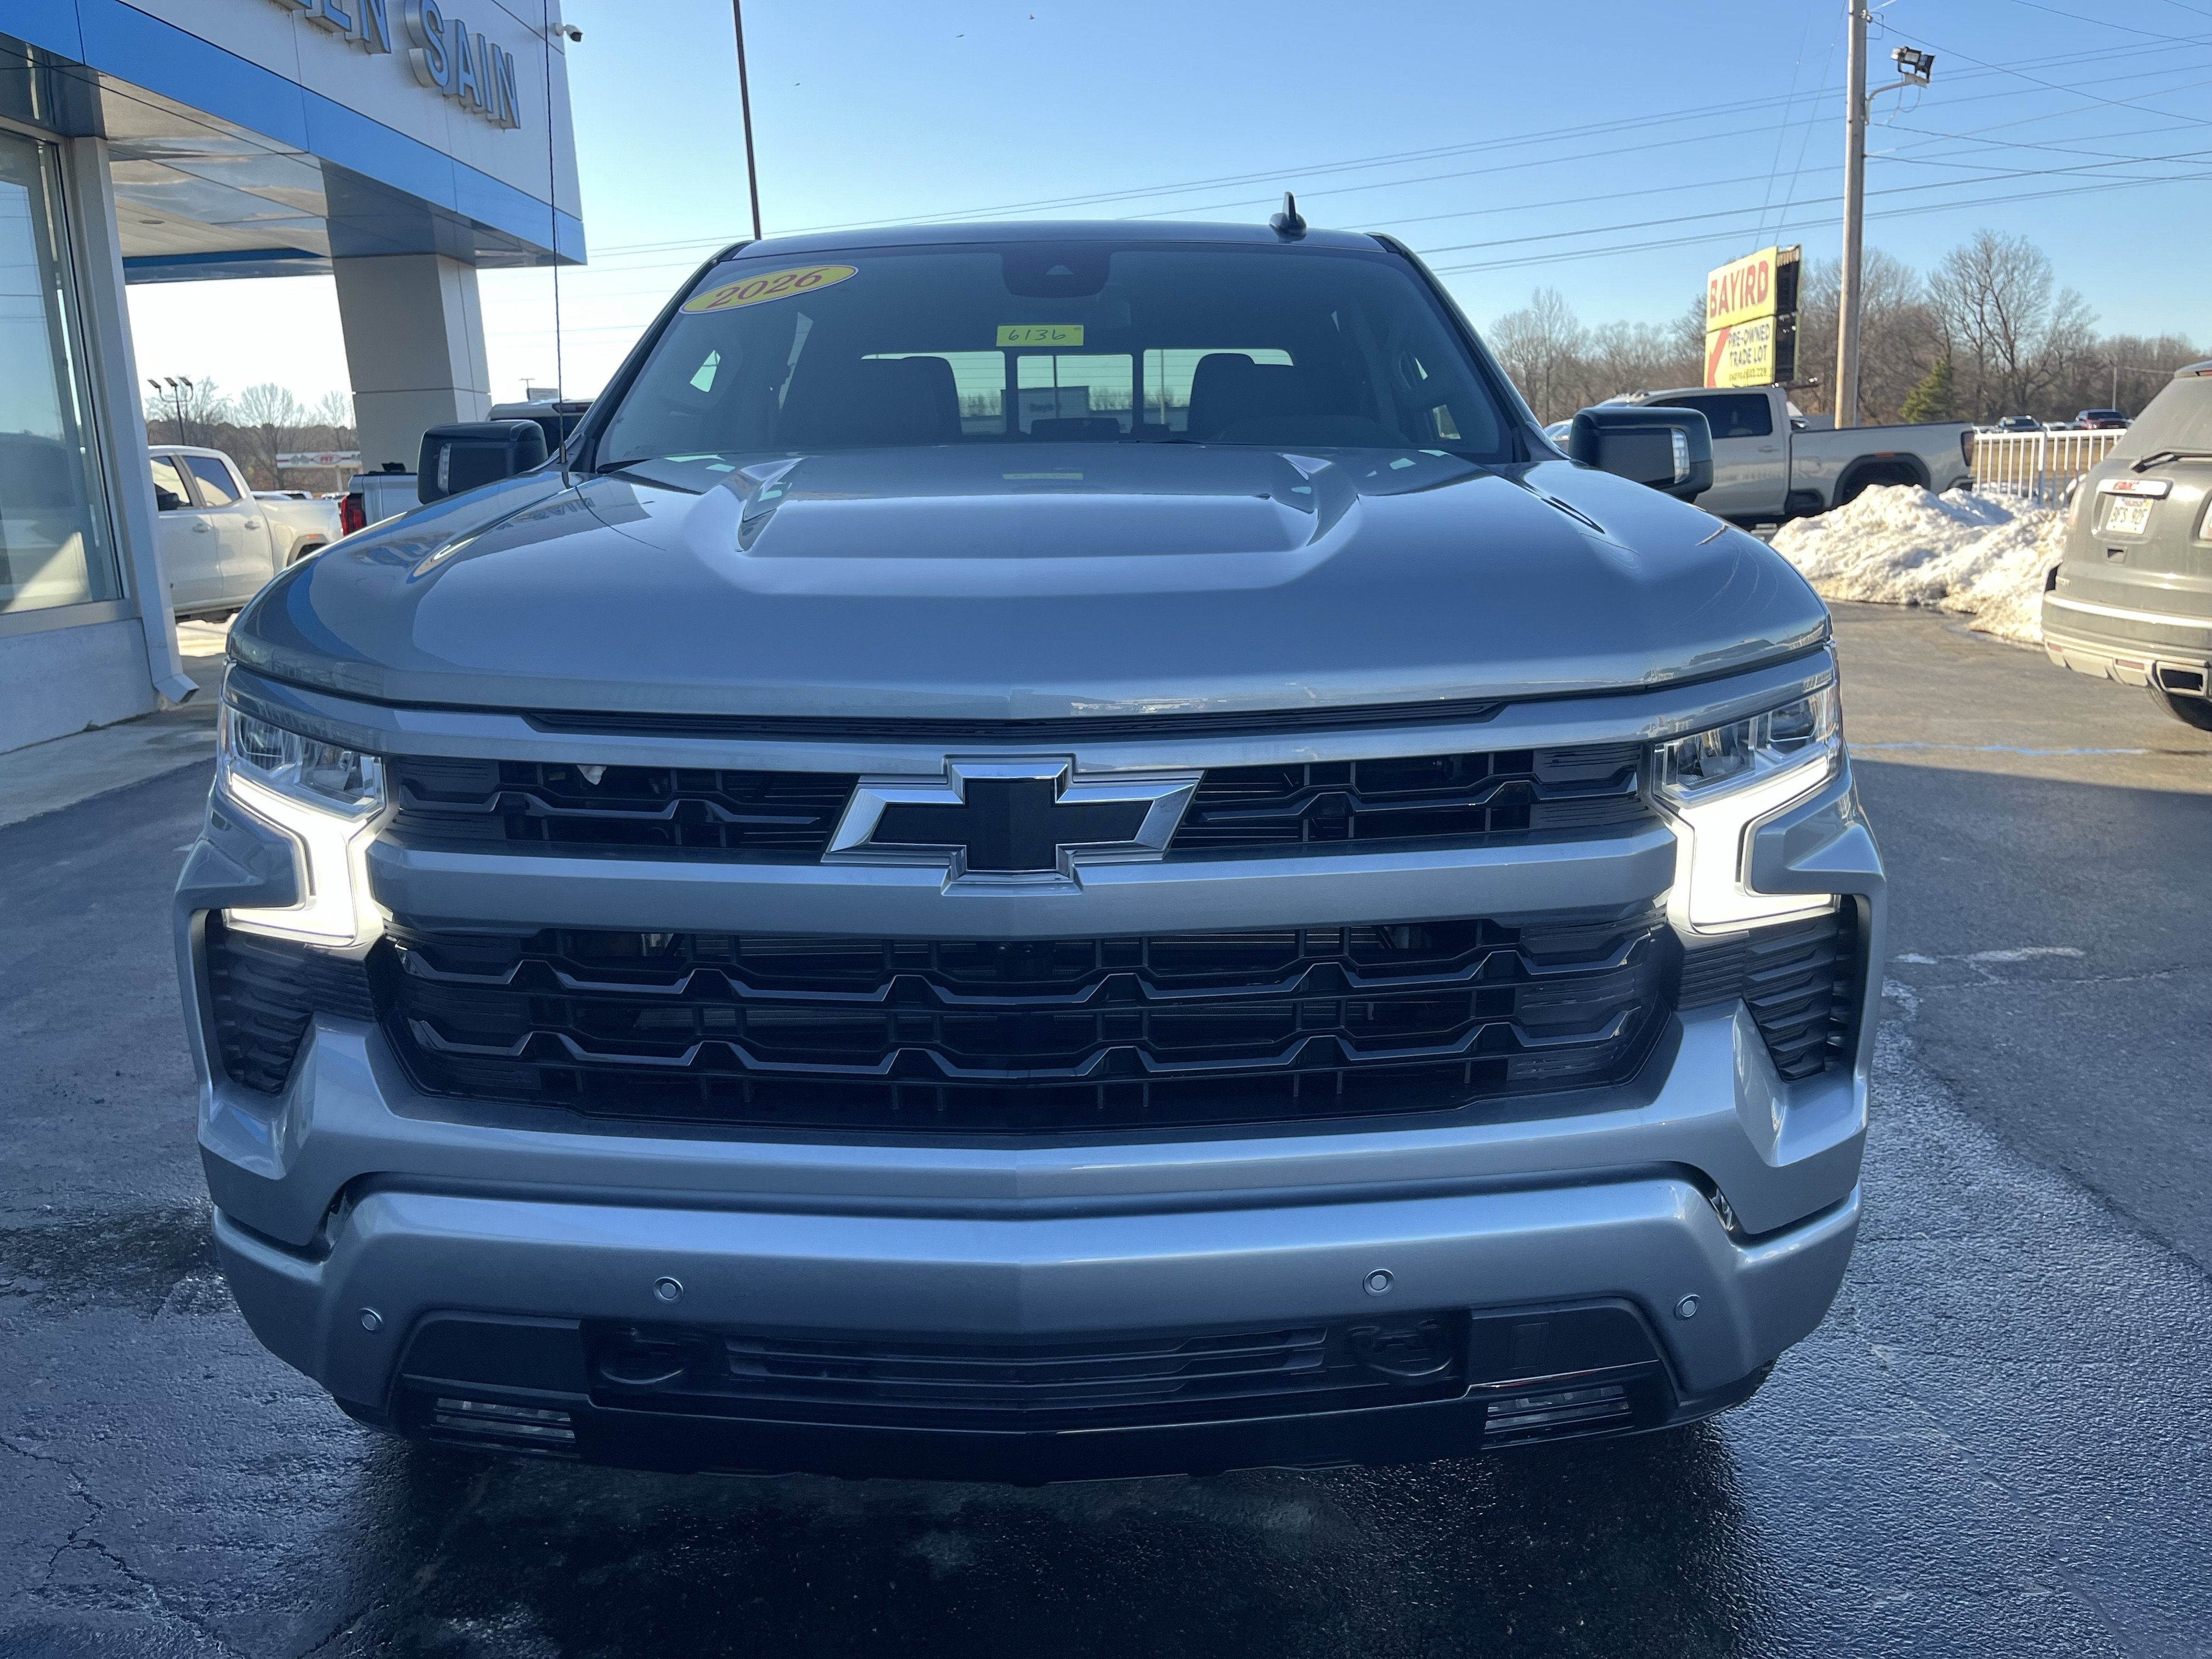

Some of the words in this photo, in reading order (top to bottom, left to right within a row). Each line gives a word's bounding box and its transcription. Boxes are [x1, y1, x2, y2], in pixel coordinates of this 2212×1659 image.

[405, 0, 521, 129] SAIN
[706, 268, 831, 309] 2026
[1710, 261, 1769, 318] BAYIRD
[1008, 329, 1066, 341] 6136
[1728, 323, 1770, 348] PRE-OWNED
[1730, 348, 1752, 368] TRADE
[1753, 345, 1768, 363] LOT
